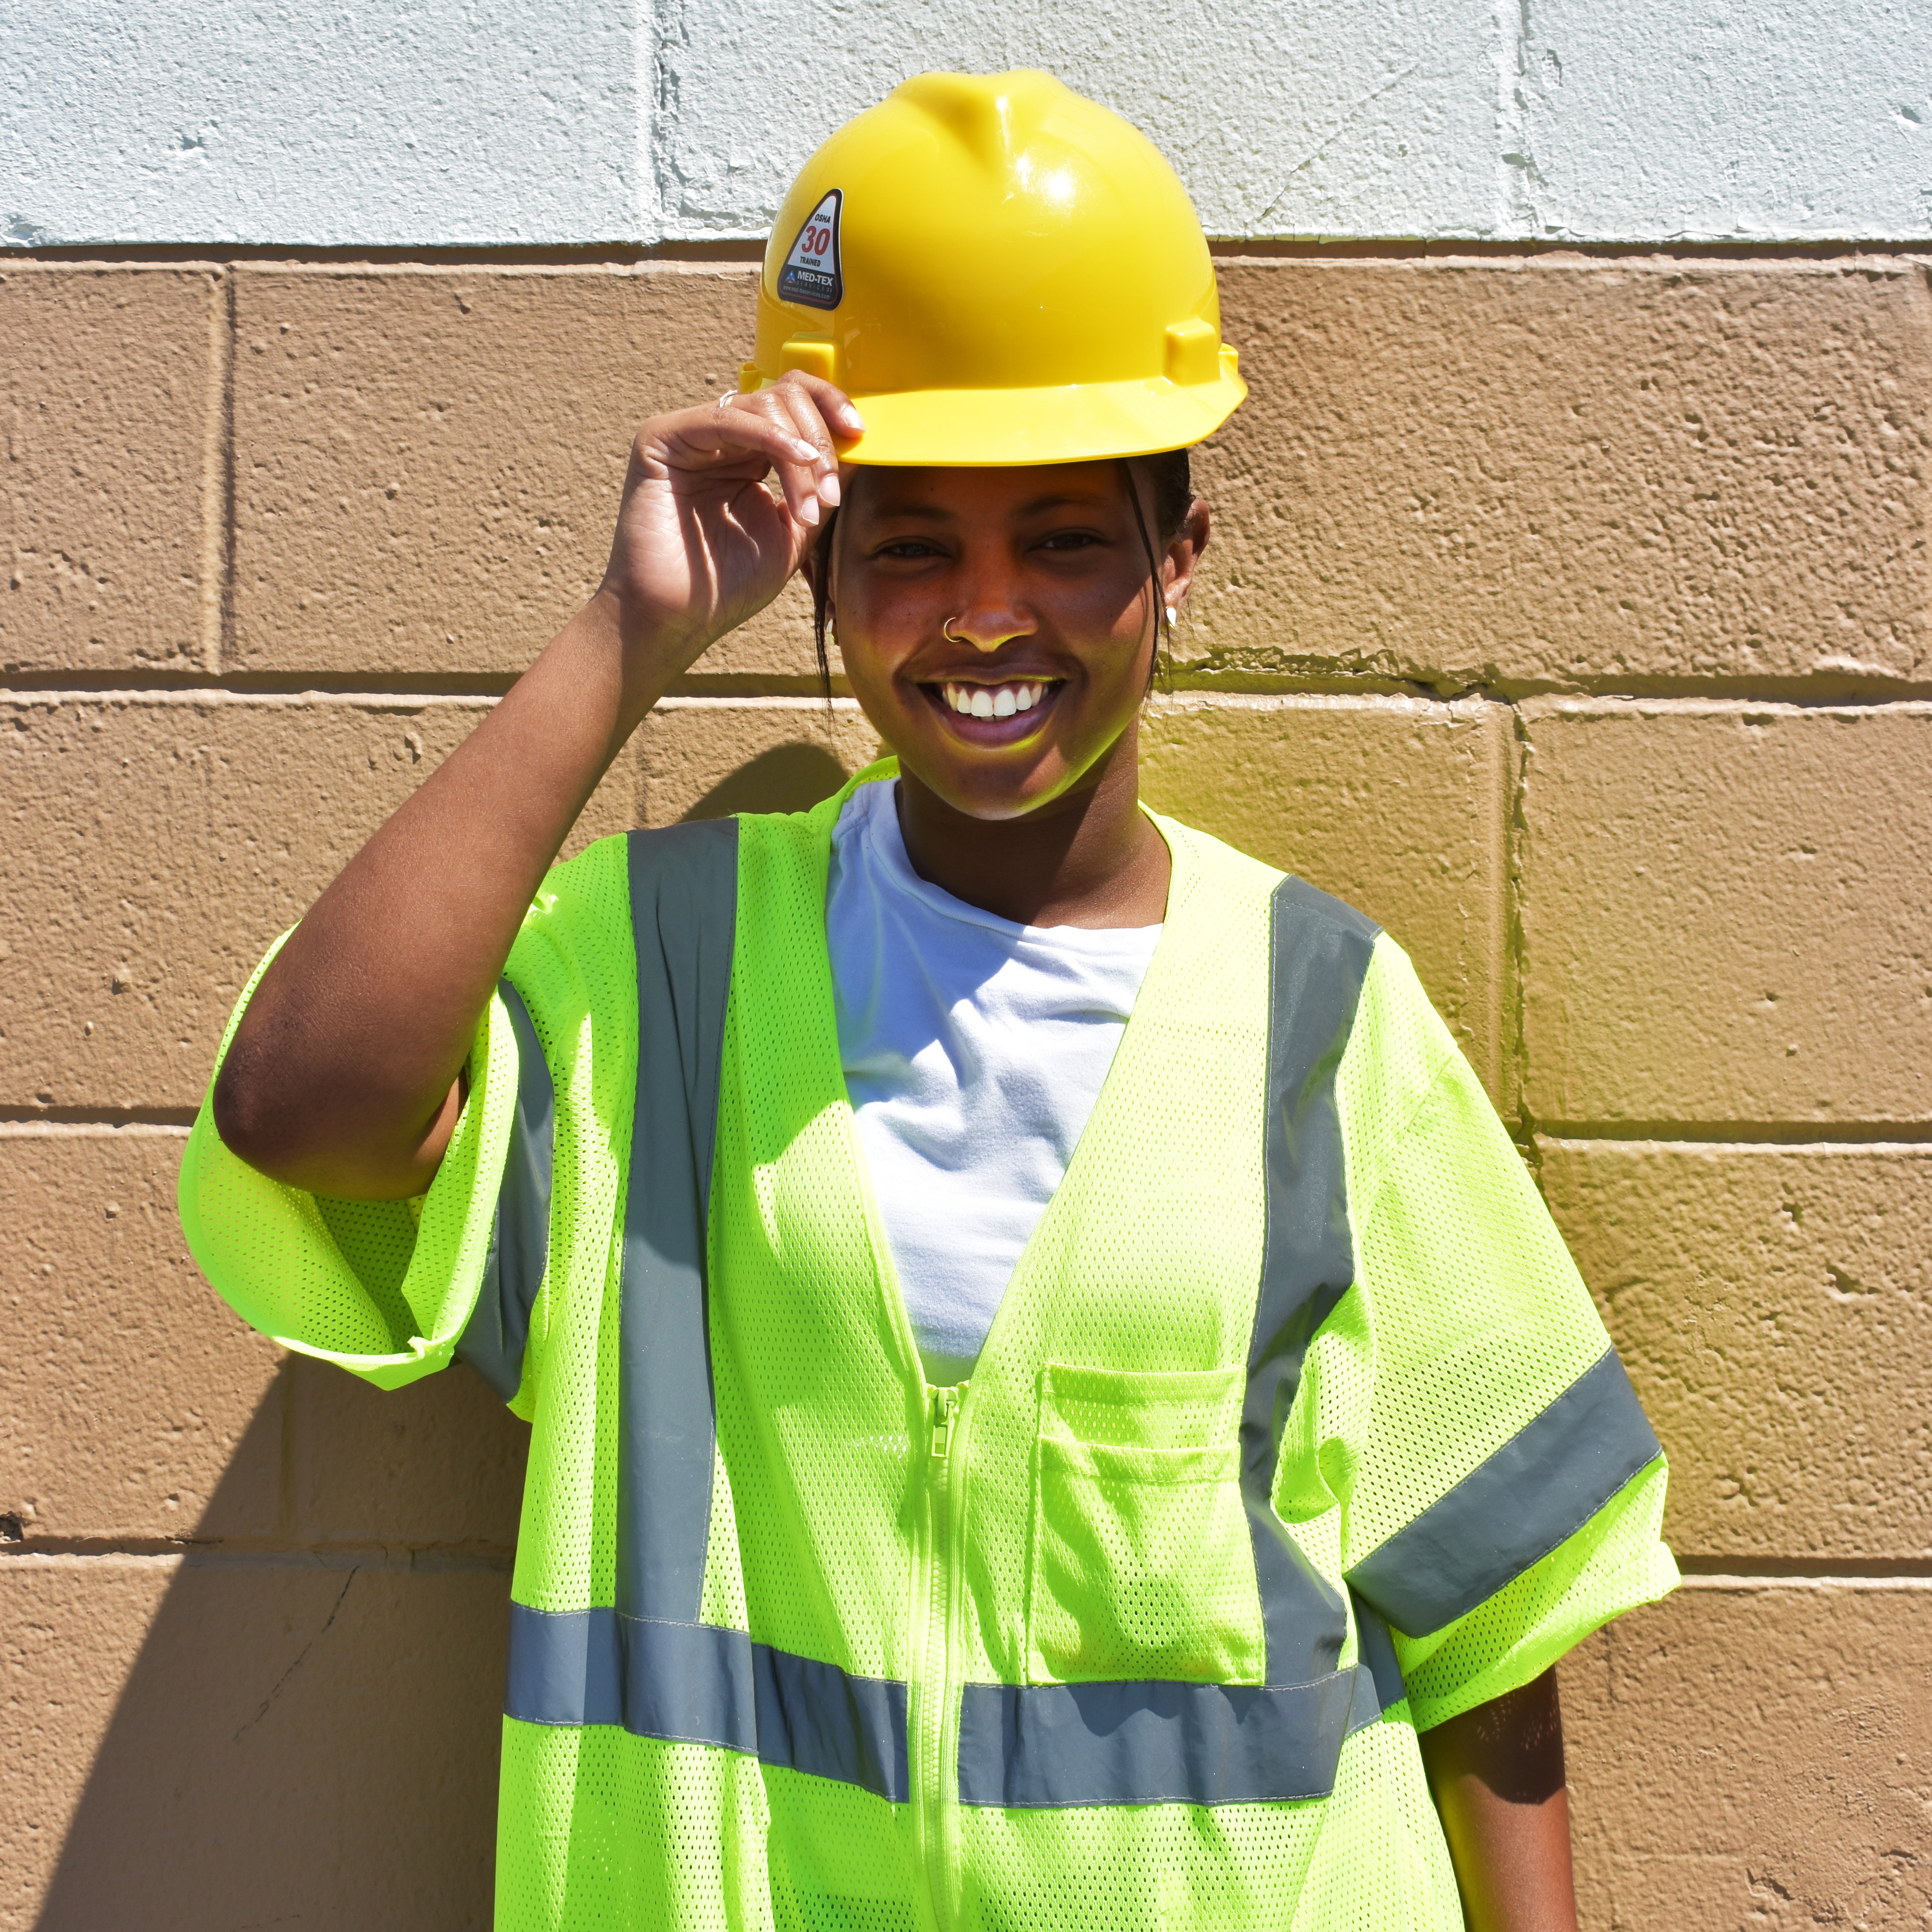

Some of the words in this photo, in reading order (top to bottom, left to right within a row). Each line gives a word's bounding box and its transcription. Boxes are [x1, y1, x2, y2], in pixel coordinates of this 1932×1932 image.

[815, 214, 831, 224] OSHA
[801, 225, 831, 256] 30
[800, 256, 821, 267] TRAINED
[797, 271, 833, 286] MED-TEX
